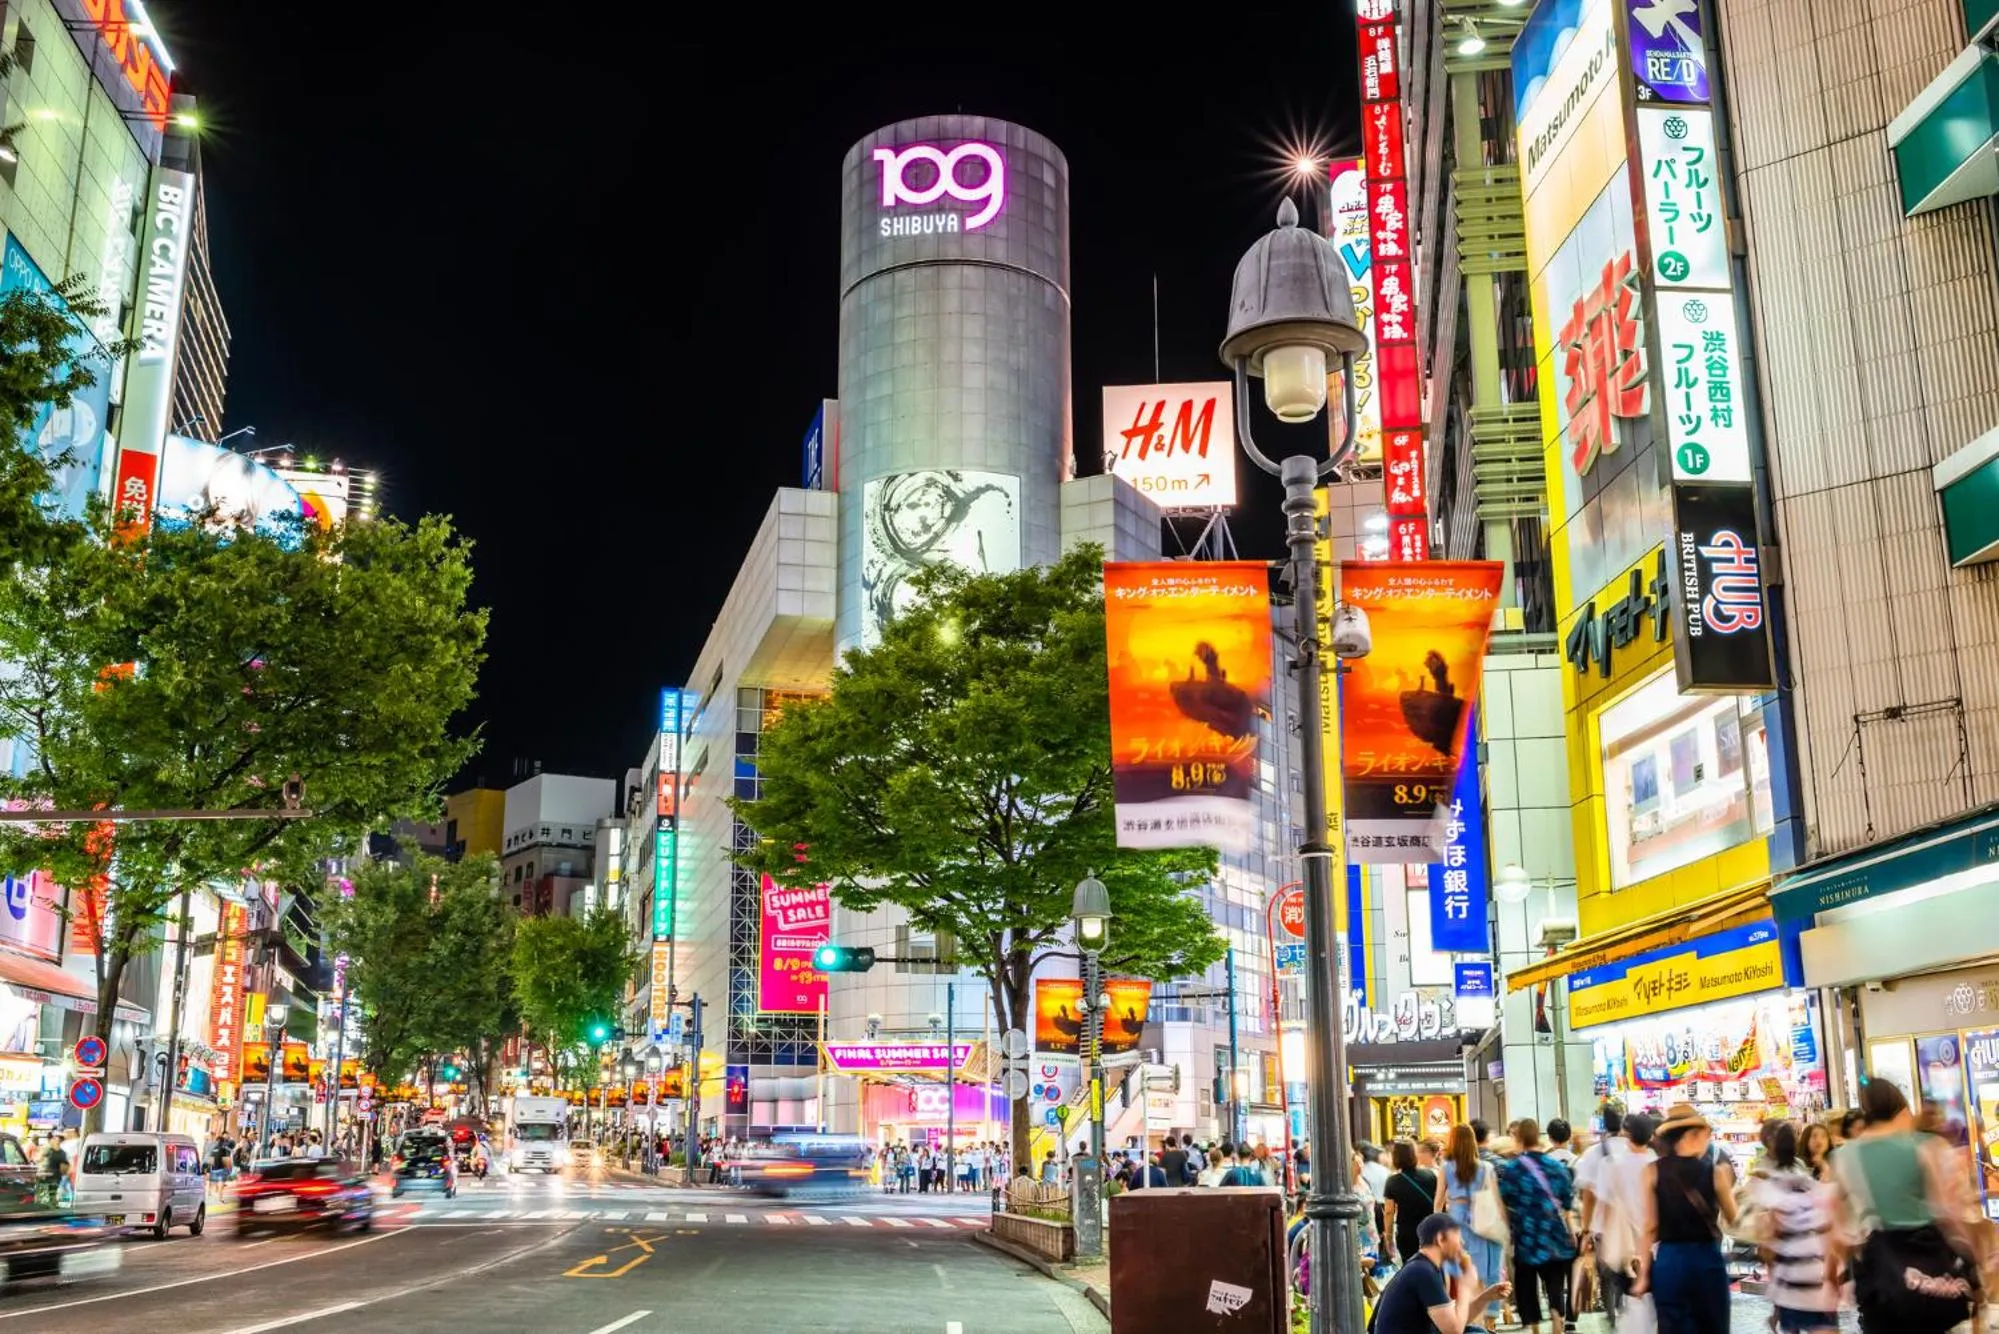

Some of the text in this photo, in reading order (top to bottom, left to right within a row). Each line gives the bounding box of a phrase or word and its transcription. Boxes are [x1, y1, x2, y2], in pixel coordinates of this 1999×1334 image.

[1527, 48, 1604, 174] Matsumoto
[1637, 85, 1652, 100] 3F
[873, 142, 1005, 231] 109
[1653, 158, 1680, 245] パーラー
[1682, 146, 1712, 233] フルーツ
[880, 213, 959, 236] SHIBUYA
[8, 247, 33, 288] OPPO
[140, 183, 185, 361] BIC CAMERA
[1662, 257, 1685, 276] 2F
[1671, 343, 1702, 437] フルーツ
[1701, 330, 1734, 429] 渋谷西村
[1120, 397, 1216, 461] H&M
[1683, 448, 1705, 467] 1F
[122, 476, 148, 525] 免税
[1130, 472, 1189, 492] 150m
[1399, 523, 1416, 534] 6F
[1681, 532, 1704, 637] BRITISH PUB
[1698, 529, 1762, 635] HUB
[1171, 762, 1205, 790] 8.9
[1394, 784, 1428, 805] 8.9
[787, 905, 826, 922] SALE
[1819, 884, 1870, 906] NISHIMURA
[652, 949, 668, 1020] HOOTERS
[1633, 968, 1692, 1006] マツモトキヨシ
[1699, 960, 1774, 990] Matsumoto KiYoshi
[834, 1048, 874, 1060] FINAL
[874, 1048, 931, 1060] SUMMER
